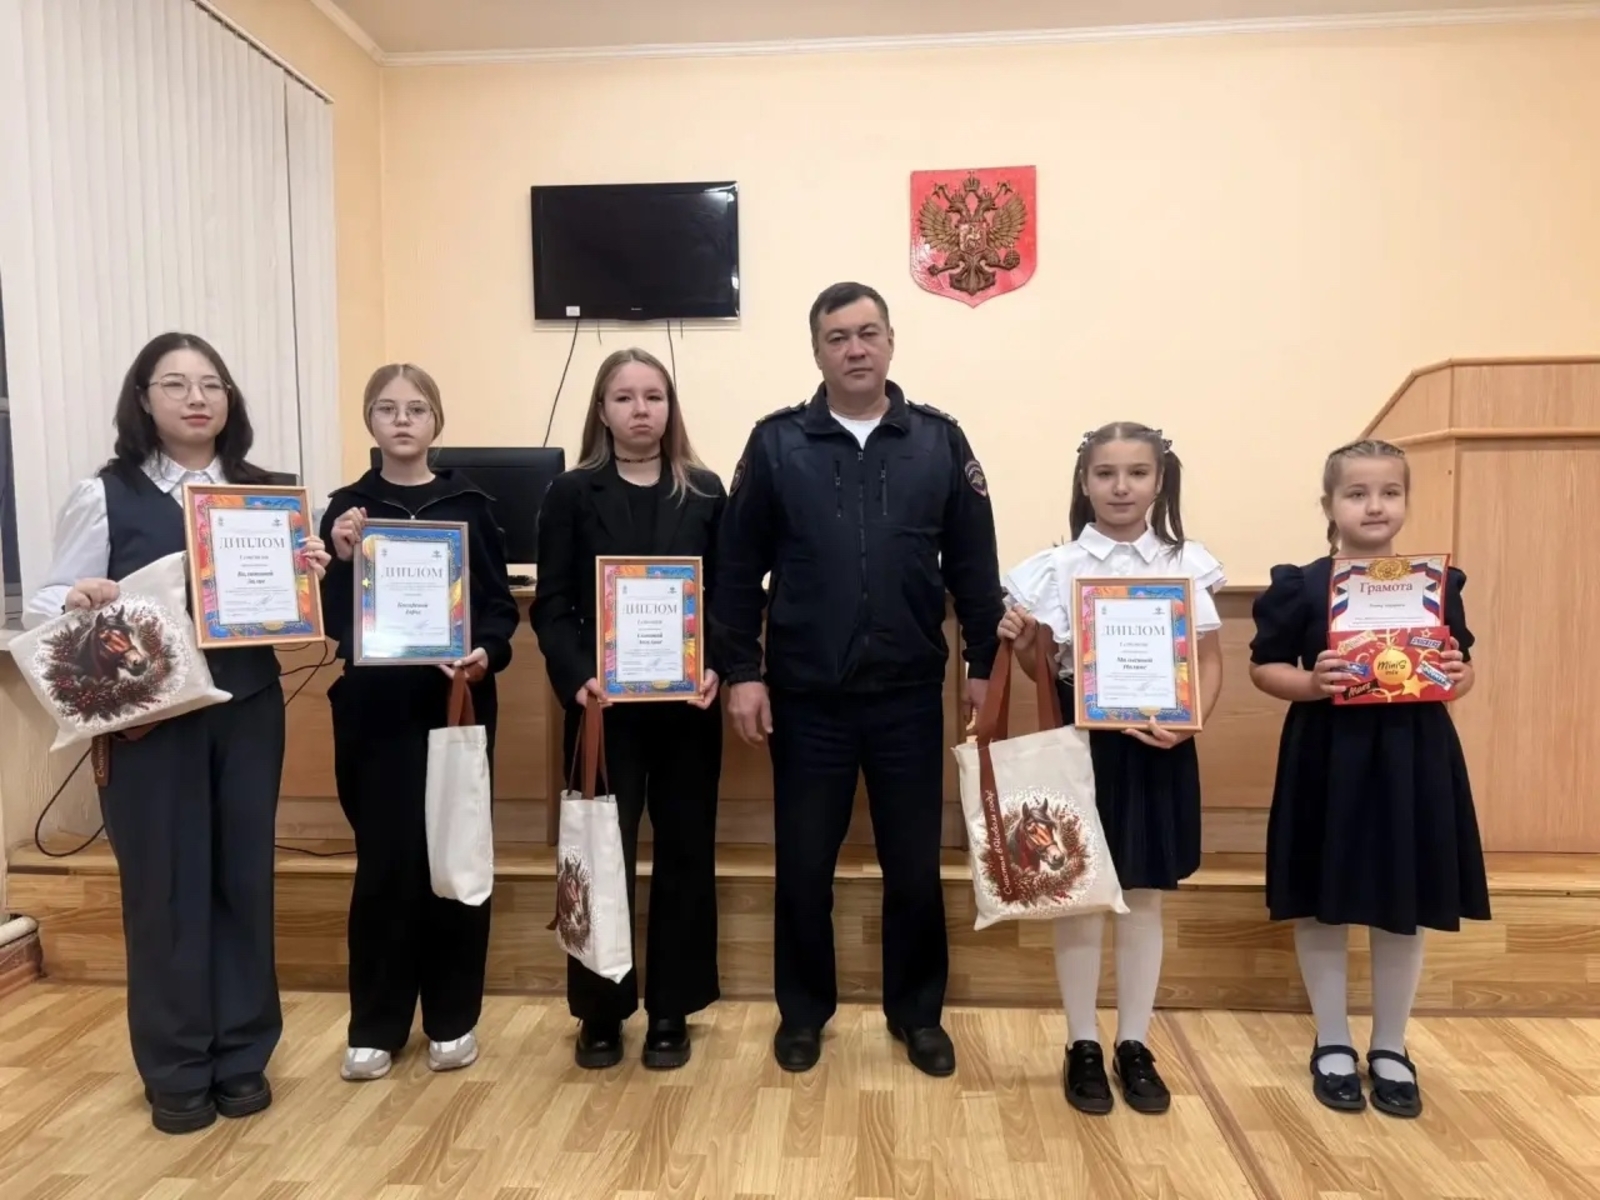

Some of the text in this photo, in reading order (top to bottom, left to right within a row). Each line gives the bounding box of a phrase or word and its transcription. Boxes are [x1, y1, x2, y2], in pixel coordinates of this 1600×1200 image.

[219, 537, 285, 550] ДИПЛОМ
[381, 567, 444, 578] ДИПЛОМ
[1360, 581, 1413, 595] Грамота
[622, 603, 678, 615] ДИПЛОМ
[1102, 625, 1166, 636] ДИПЛОМ
